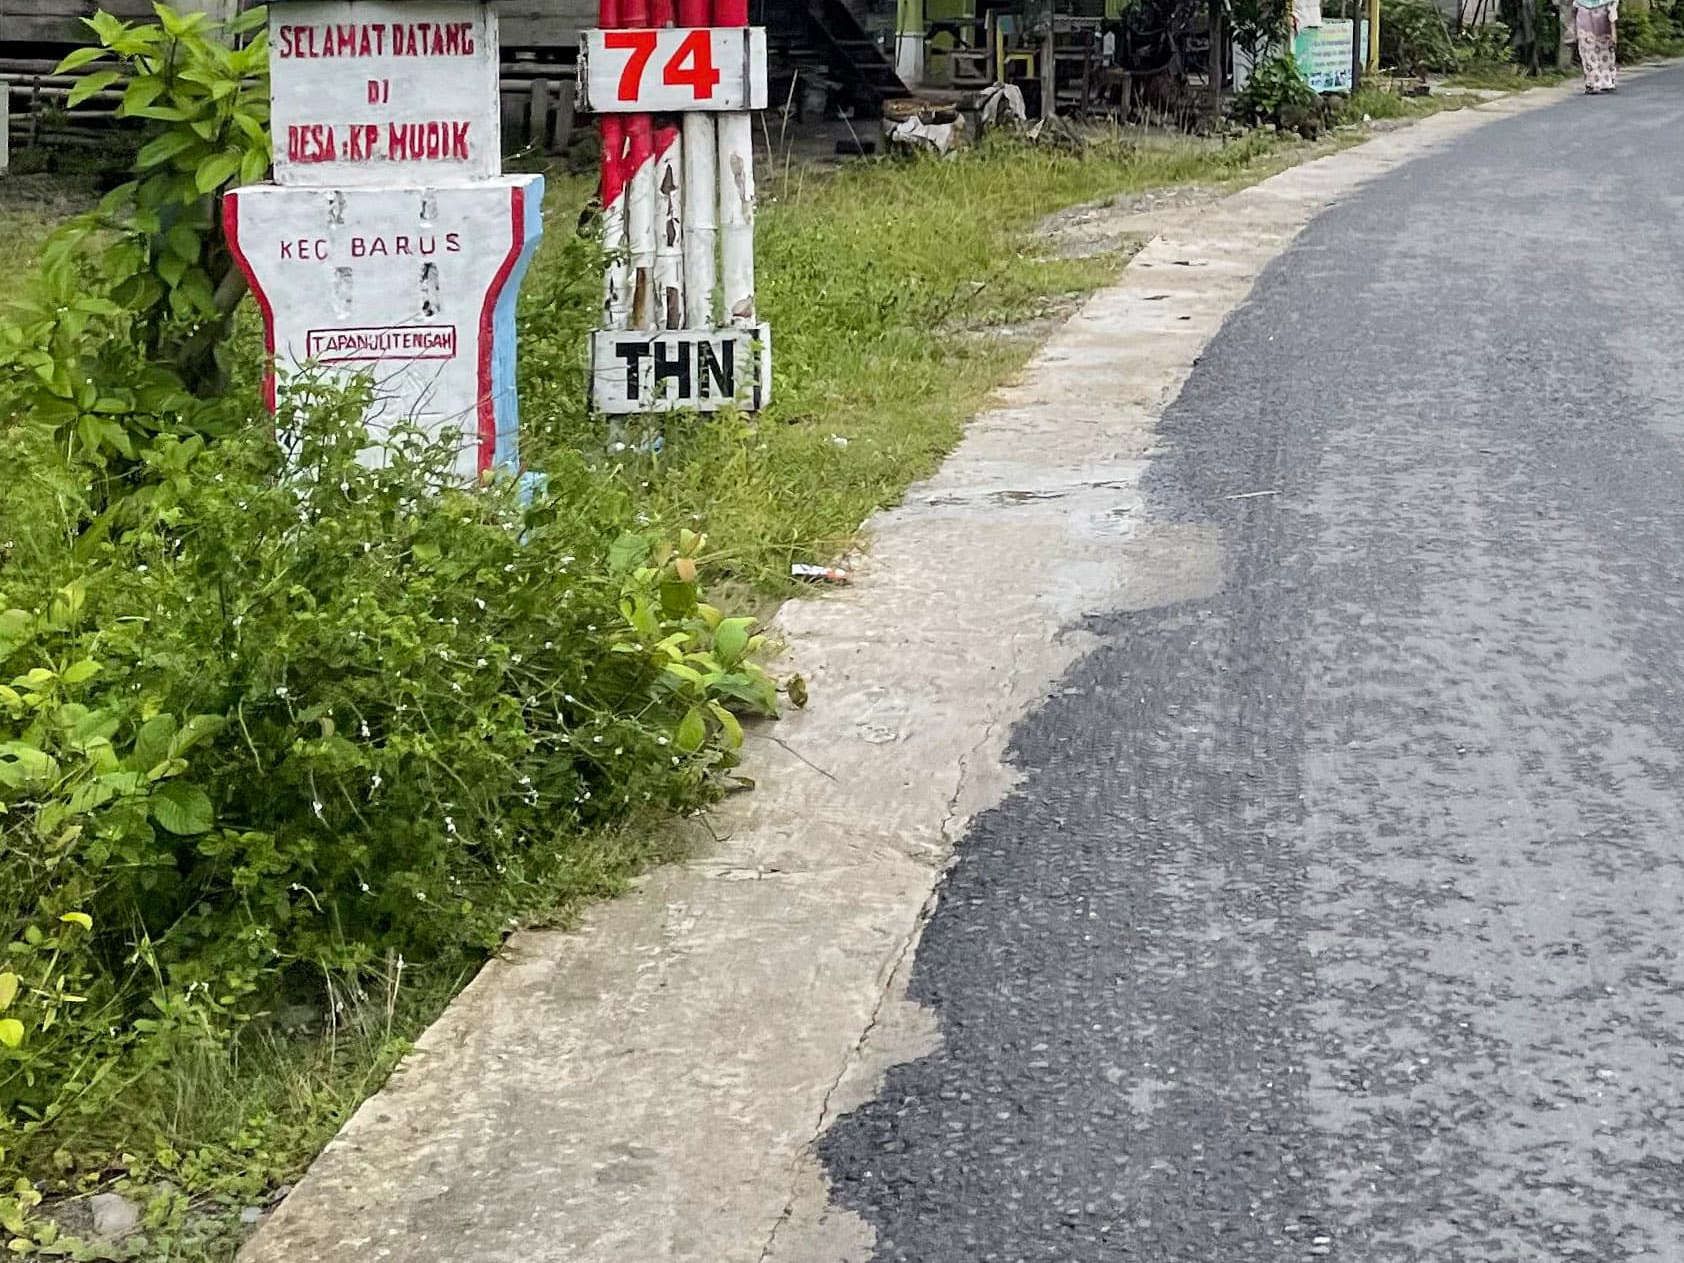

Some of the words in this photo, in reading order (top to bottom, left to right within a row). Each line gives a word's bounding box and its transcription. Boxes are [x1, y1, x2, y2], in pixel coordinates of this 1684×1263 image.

[279, 23, 386, 58] SELAMAT
[392, 22, 475, 57] DATANG
[603, 29, 720, 102] 74
[367, 78, 390, 105] DI
[288, 124, 337, 163] DESA
[388, 121, 471, 161] MUDIK
[280, 239, 329, 261] KEC
[351, 232, 462, 258] BARUS
[615, 340, 735, 401] THN
